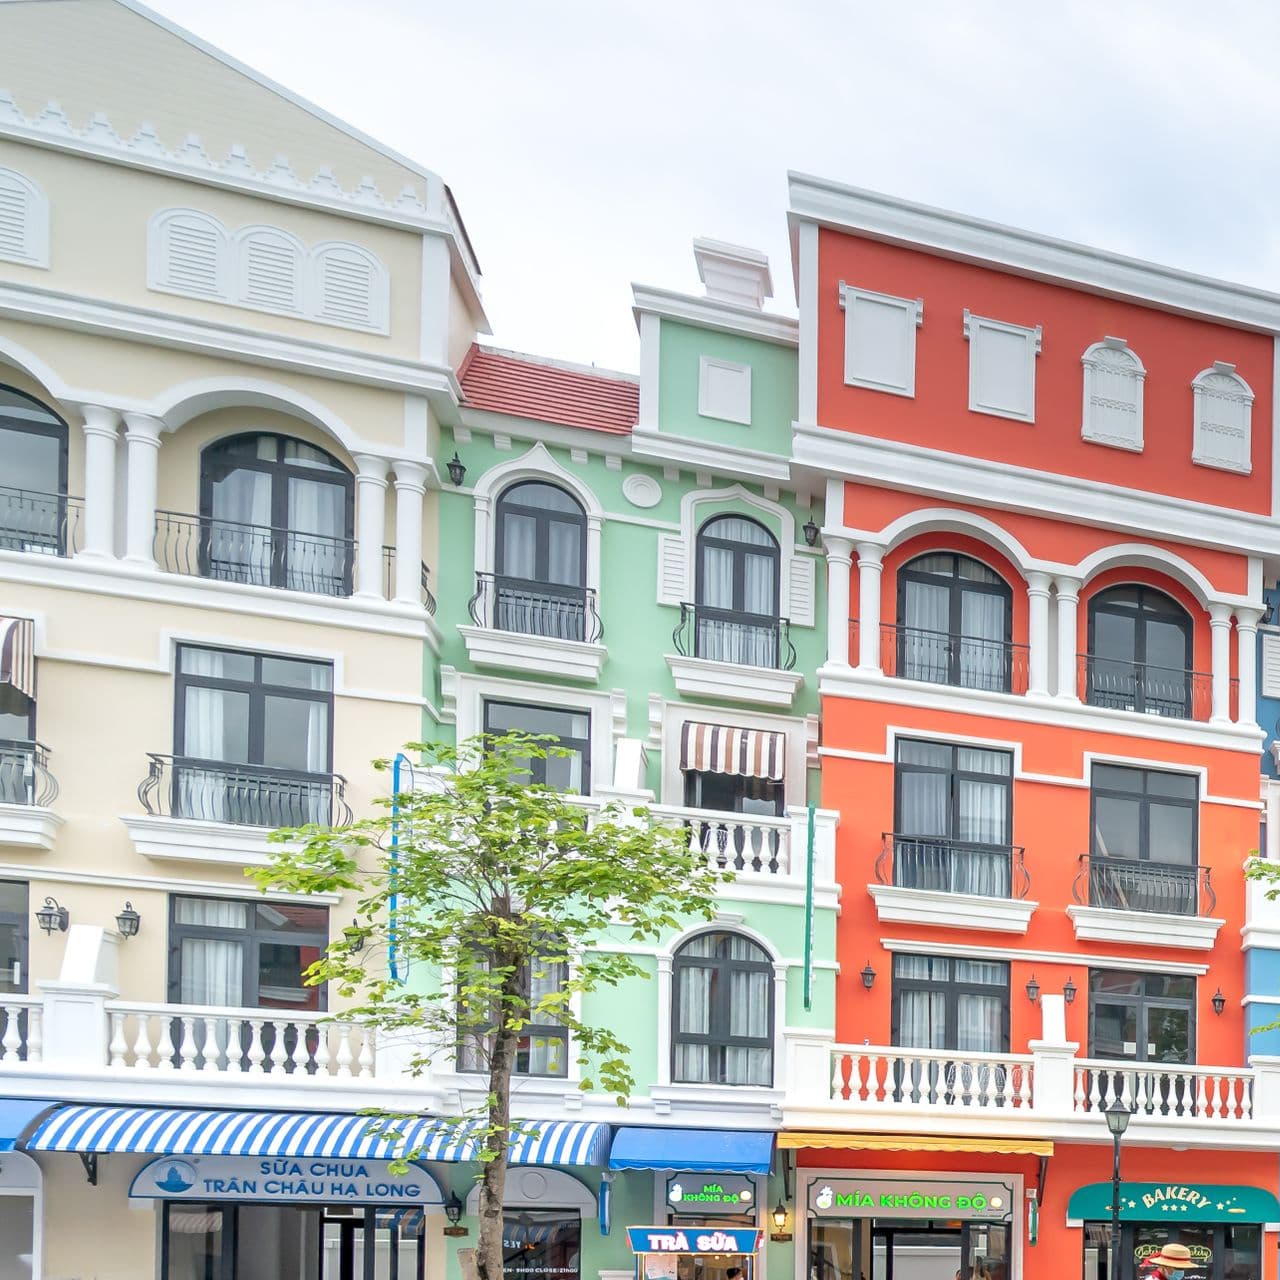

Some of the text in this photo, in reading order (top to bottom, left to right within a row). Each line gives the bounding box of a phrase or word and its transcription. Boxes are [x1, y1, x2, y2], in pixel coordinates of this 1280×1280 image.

[260, 1159, 369, 1178] SỮA CHUA
[203, 1176, 421, 1199] TRÂN CHÂU HẠ LONG
[703, 1184, 723, 1193] MÍA
[1142, 1186, 1211, 1208] BAKERY
[683, 1192, 739, 1204] KHÔNG ĐỘ
[835, 1189, 987, 1213] MÍA KHÔNG ĐỘ
[647, 1231, 738, 1251] TRÀ SỮA
